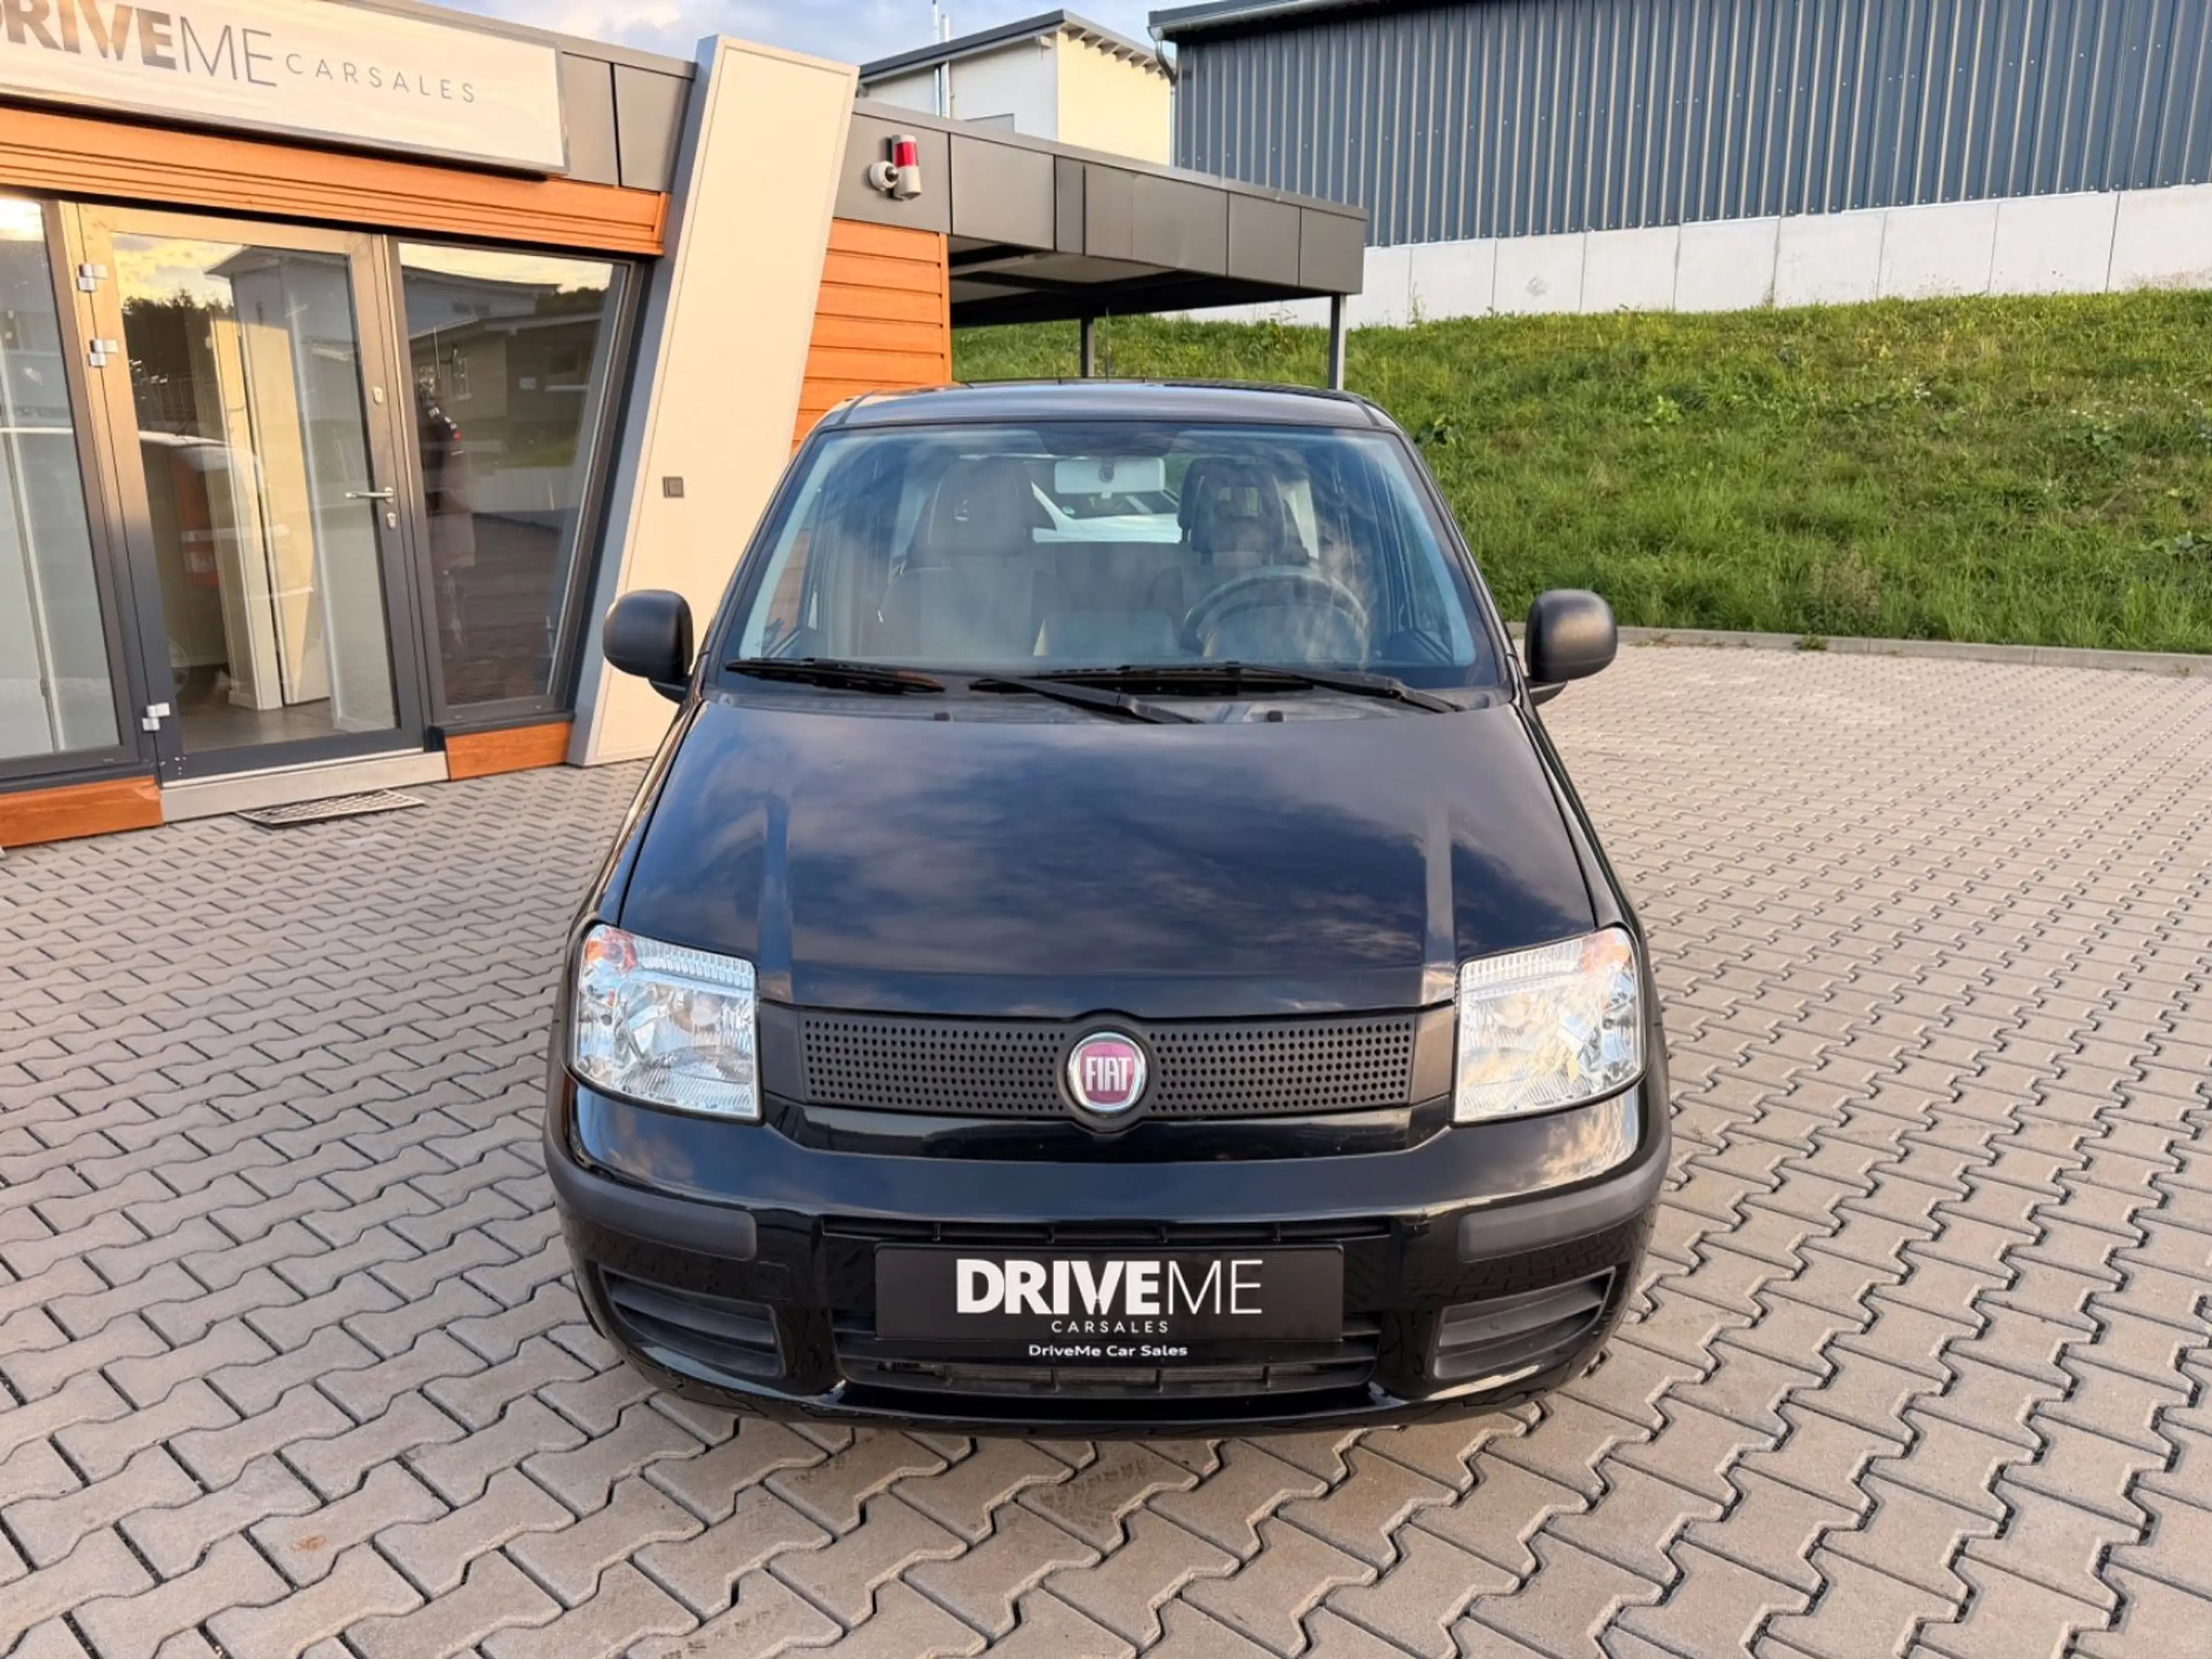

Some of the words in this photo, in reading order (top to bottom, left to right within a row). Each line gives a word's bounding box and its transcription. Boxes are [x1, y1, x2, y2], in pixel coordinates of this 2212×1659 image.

[0, 0, 278, 88] RIVEME
[286, 53, 475, 104] CARSALES
[1085, 1056, 1131, 1092] FIAT
[956, 1259, 1263, 1316] DRIVEME
[1051, 1320, 1169, 1334] CARSALES
[1028, 1344, 1102, 1357] DriveMe
[1106, 1344, 1137, 1357] Car
[1140, 1344, 1188, 1357] Sales
